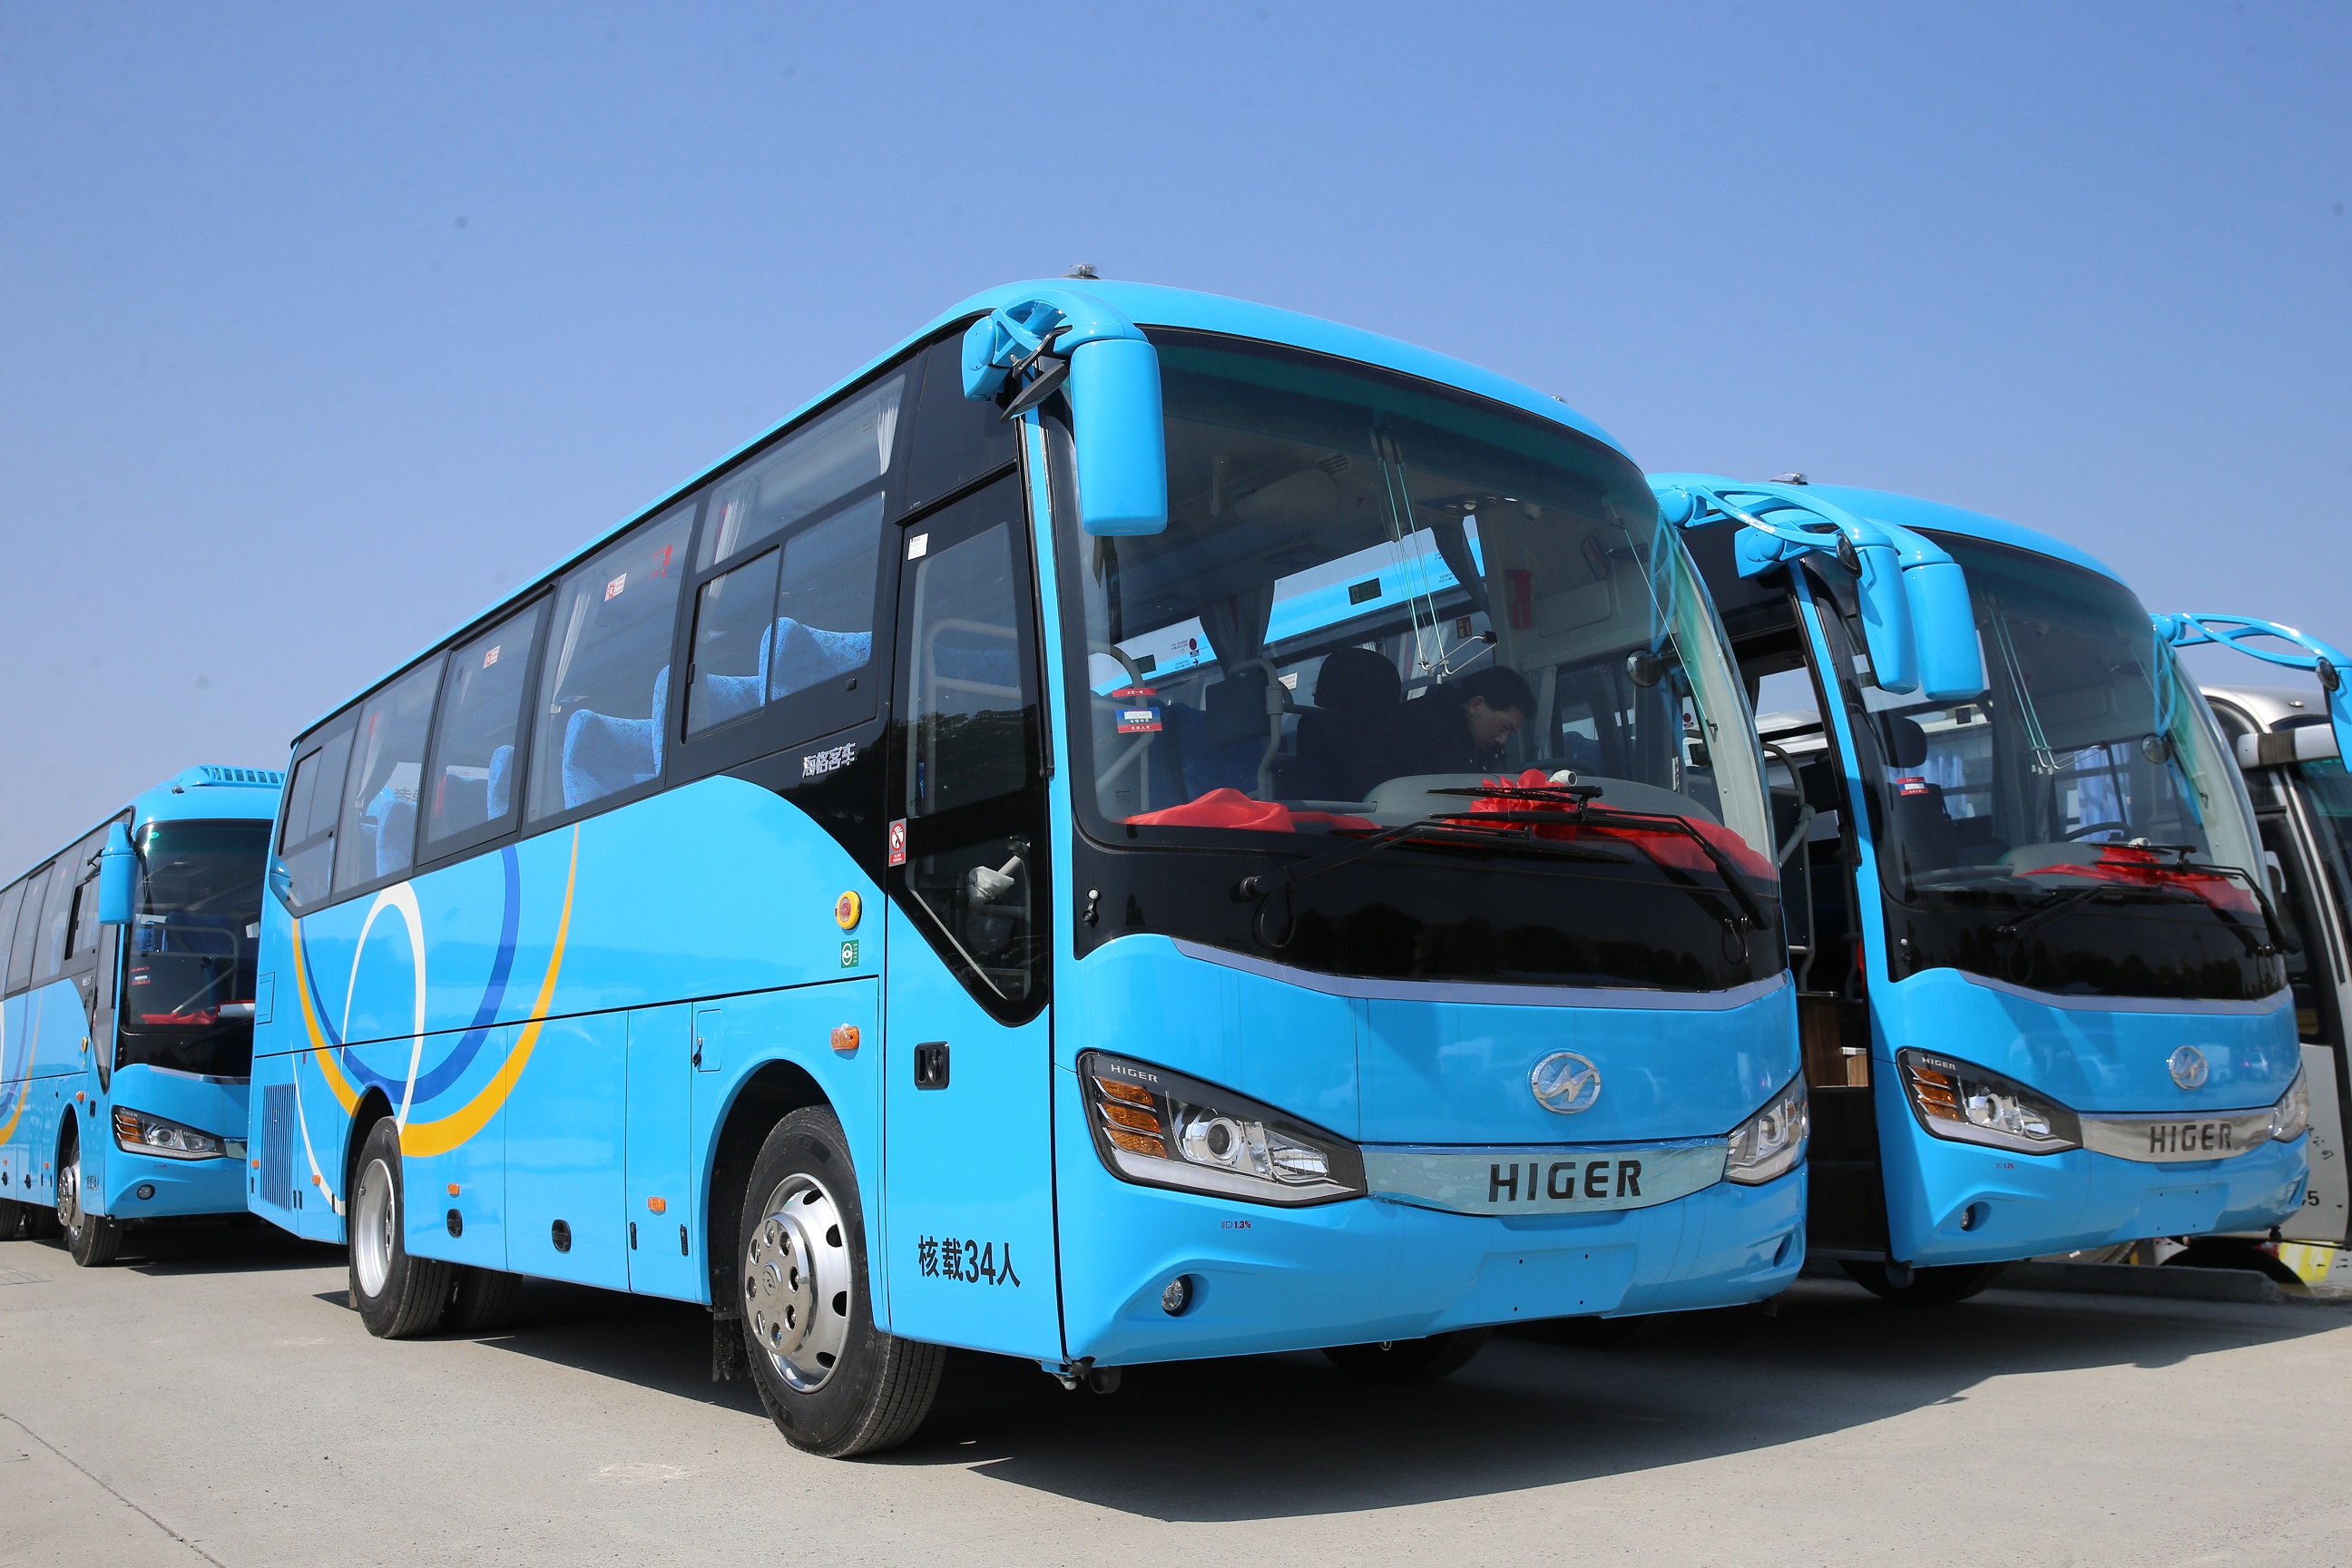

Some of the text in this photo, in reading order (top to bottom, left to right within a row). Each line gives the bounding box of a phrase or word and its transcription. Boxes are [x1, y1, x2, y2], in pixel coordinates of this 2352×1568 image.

[802, 742, 857, 779] 海格客车
[1111, 1063, 1159, 1083] HIGER
[1922, 1056, 1956, 1071] HIGER
[2150, 1122, 2232, 1153] HIGER
[1488, 1160, 1642, 1202] HIGER
[1234, 1220, 1251, 1229] 1.3%
[918, 1235, 1021, 1289] 核载34人
